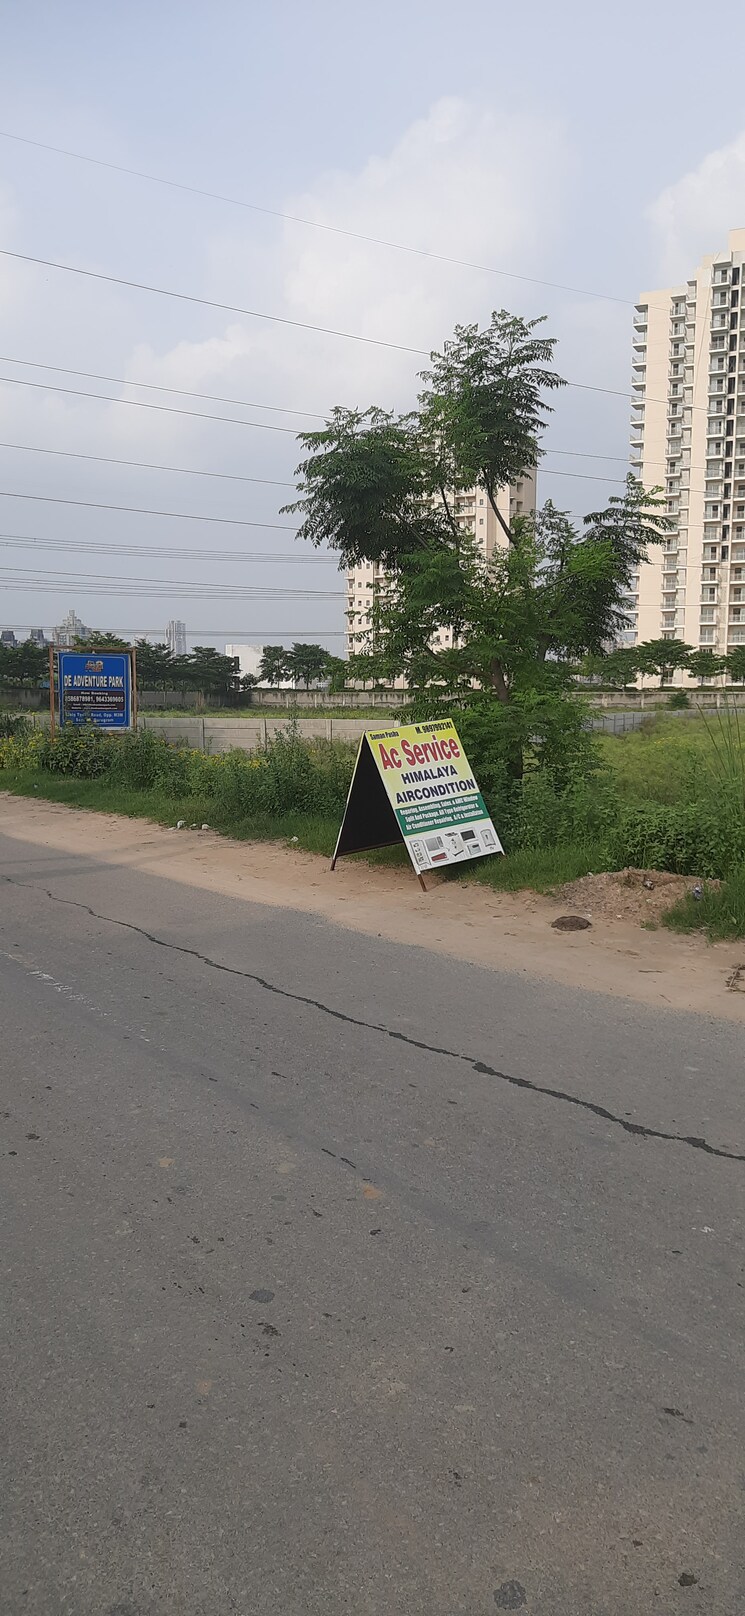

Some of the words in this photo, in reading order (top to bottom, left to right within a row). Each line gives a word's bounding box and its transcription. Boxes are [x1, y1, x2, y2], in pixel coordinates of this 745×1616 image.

[64, 675, 72, 686] DE
[74, 675, 107, 687] ADVENTURE
[109, 676, 123, 687] PARK
[378, 743, 402, 770] Ac
[400, 735, 460, 766] Service
[401, 765, 458, 785] HIMALAYA
[396, 779, 476, 804] AIRCONDITION
